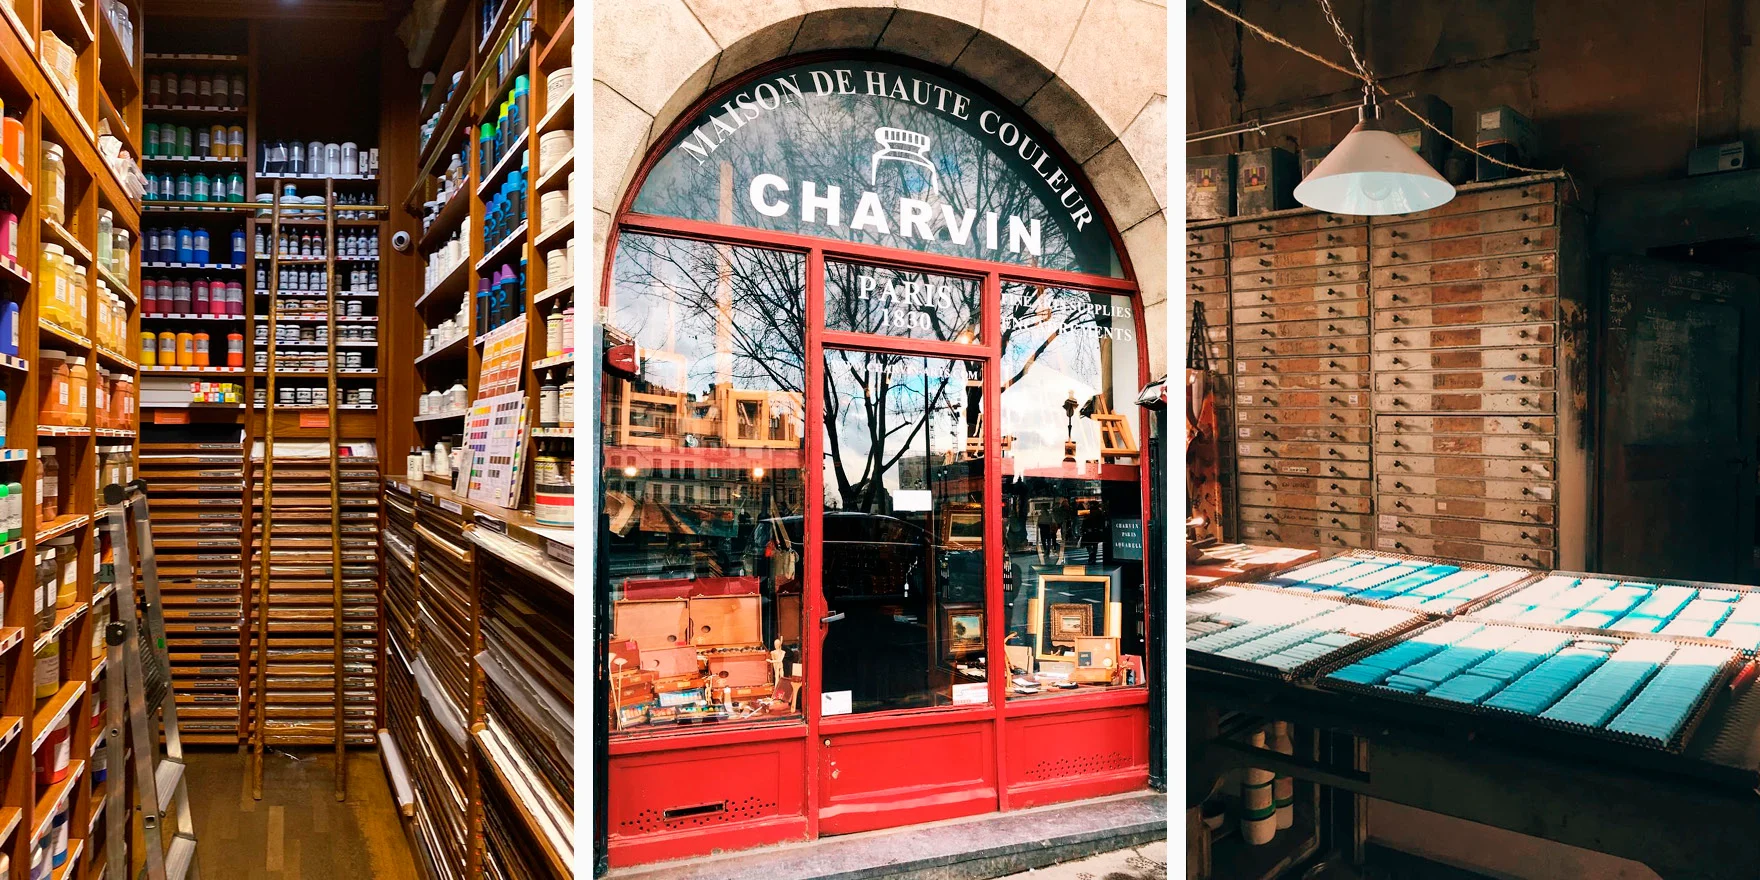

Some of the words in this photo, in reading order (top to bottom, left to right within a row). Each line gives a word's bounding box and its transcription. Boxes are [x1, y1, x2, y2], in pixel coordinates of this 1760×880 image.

[677, 73, 803, 167] MAISON
[808, 69, 857, 97] DE
[863, 70, 971, 121] HAUTE
[978, 109, 1094, 233] COULEUR
[749, 172, 1042, 257] CHARVIN
[858, 275, 951, 309] PARIS
[881, 308, 932, 331] 1830
[1070, 302, 1132, 319] SUPPLIES
